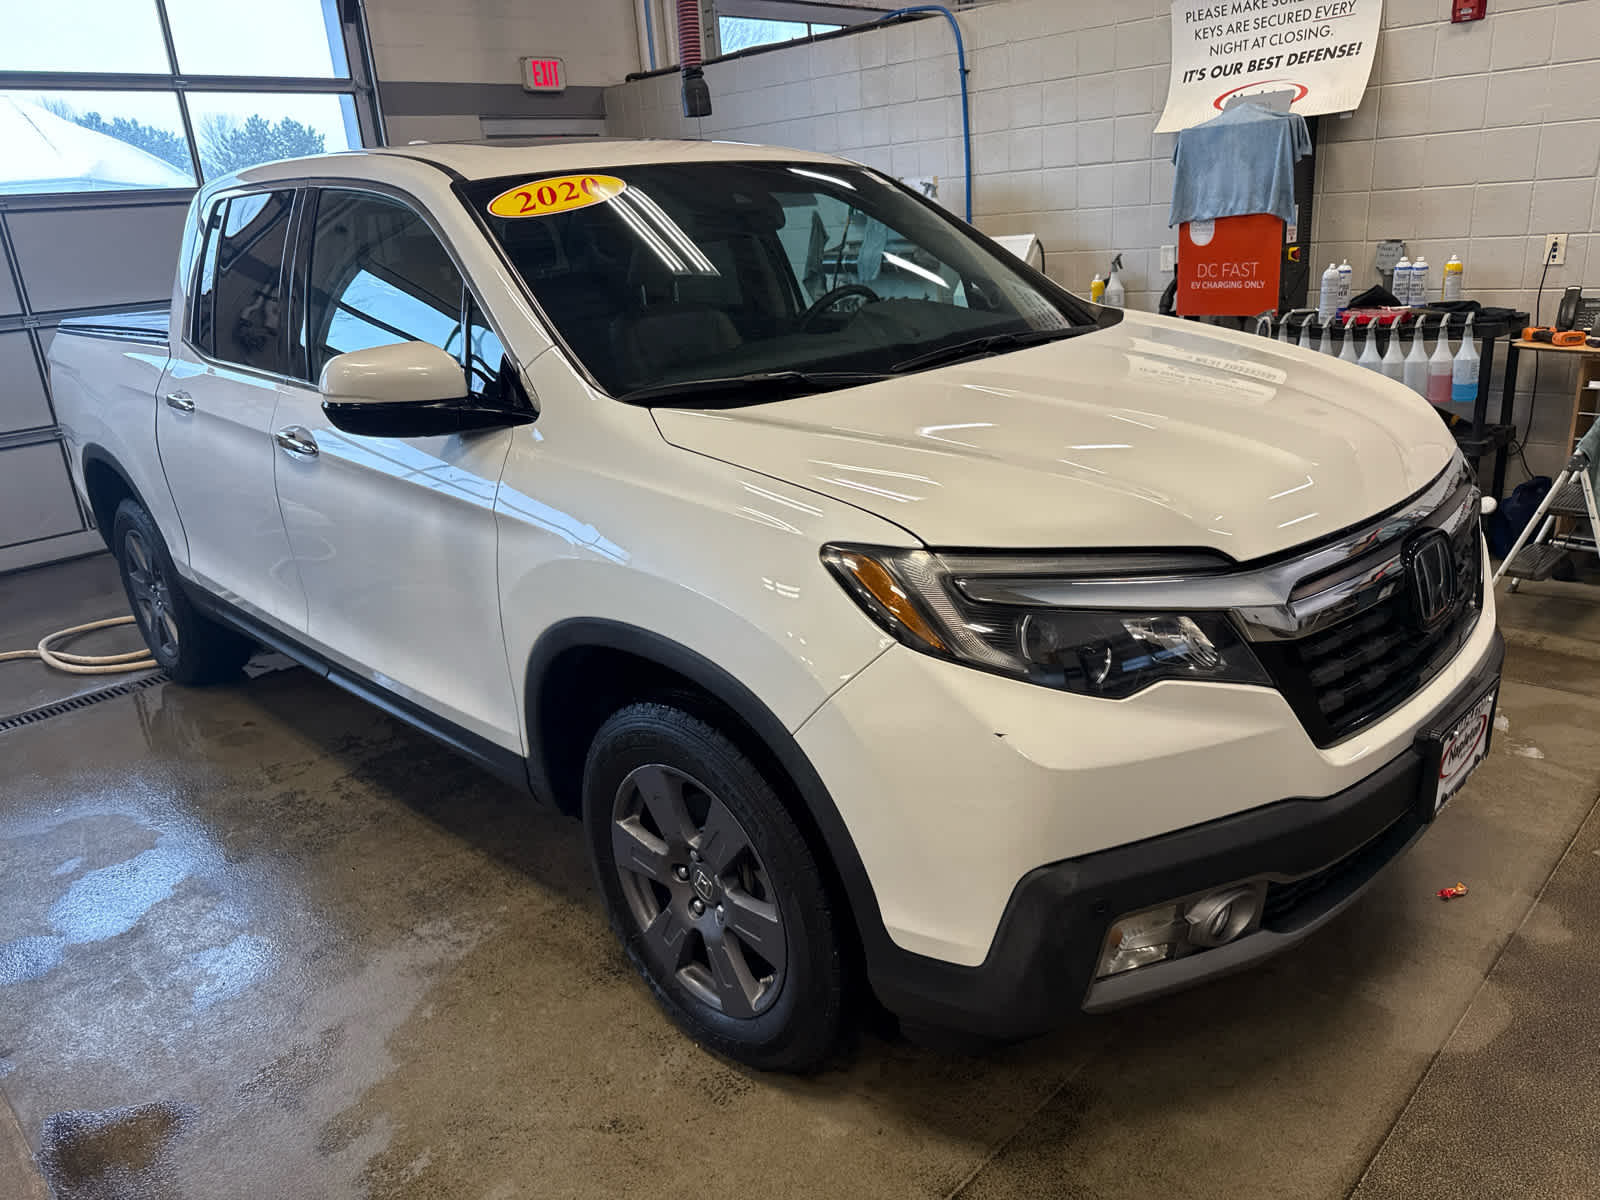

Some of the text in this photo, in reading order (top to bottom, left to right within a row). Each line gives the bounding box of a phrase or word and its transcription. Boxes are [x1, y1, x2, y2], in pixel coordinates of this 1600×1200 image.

[1185, 4, 1228, 23] PLEASE
[1231, 0, 1268, 15] MAKE
[1194, 0, 1356, 41] KEYS ARE SECURED EVERY
[1209, 25, 1334, 56] NIGHT AT CLOSING.
[532, 60, 559, 87] EXIT
[1182, 41, 1362, 84] IT'S OUR BEST DEFENSE!
[514, 177, 600, 213] 2020
[1191, 280, 1265, 289] EV CHARGING ONLY
[1197, 262, 1259, 278] DC FAST
